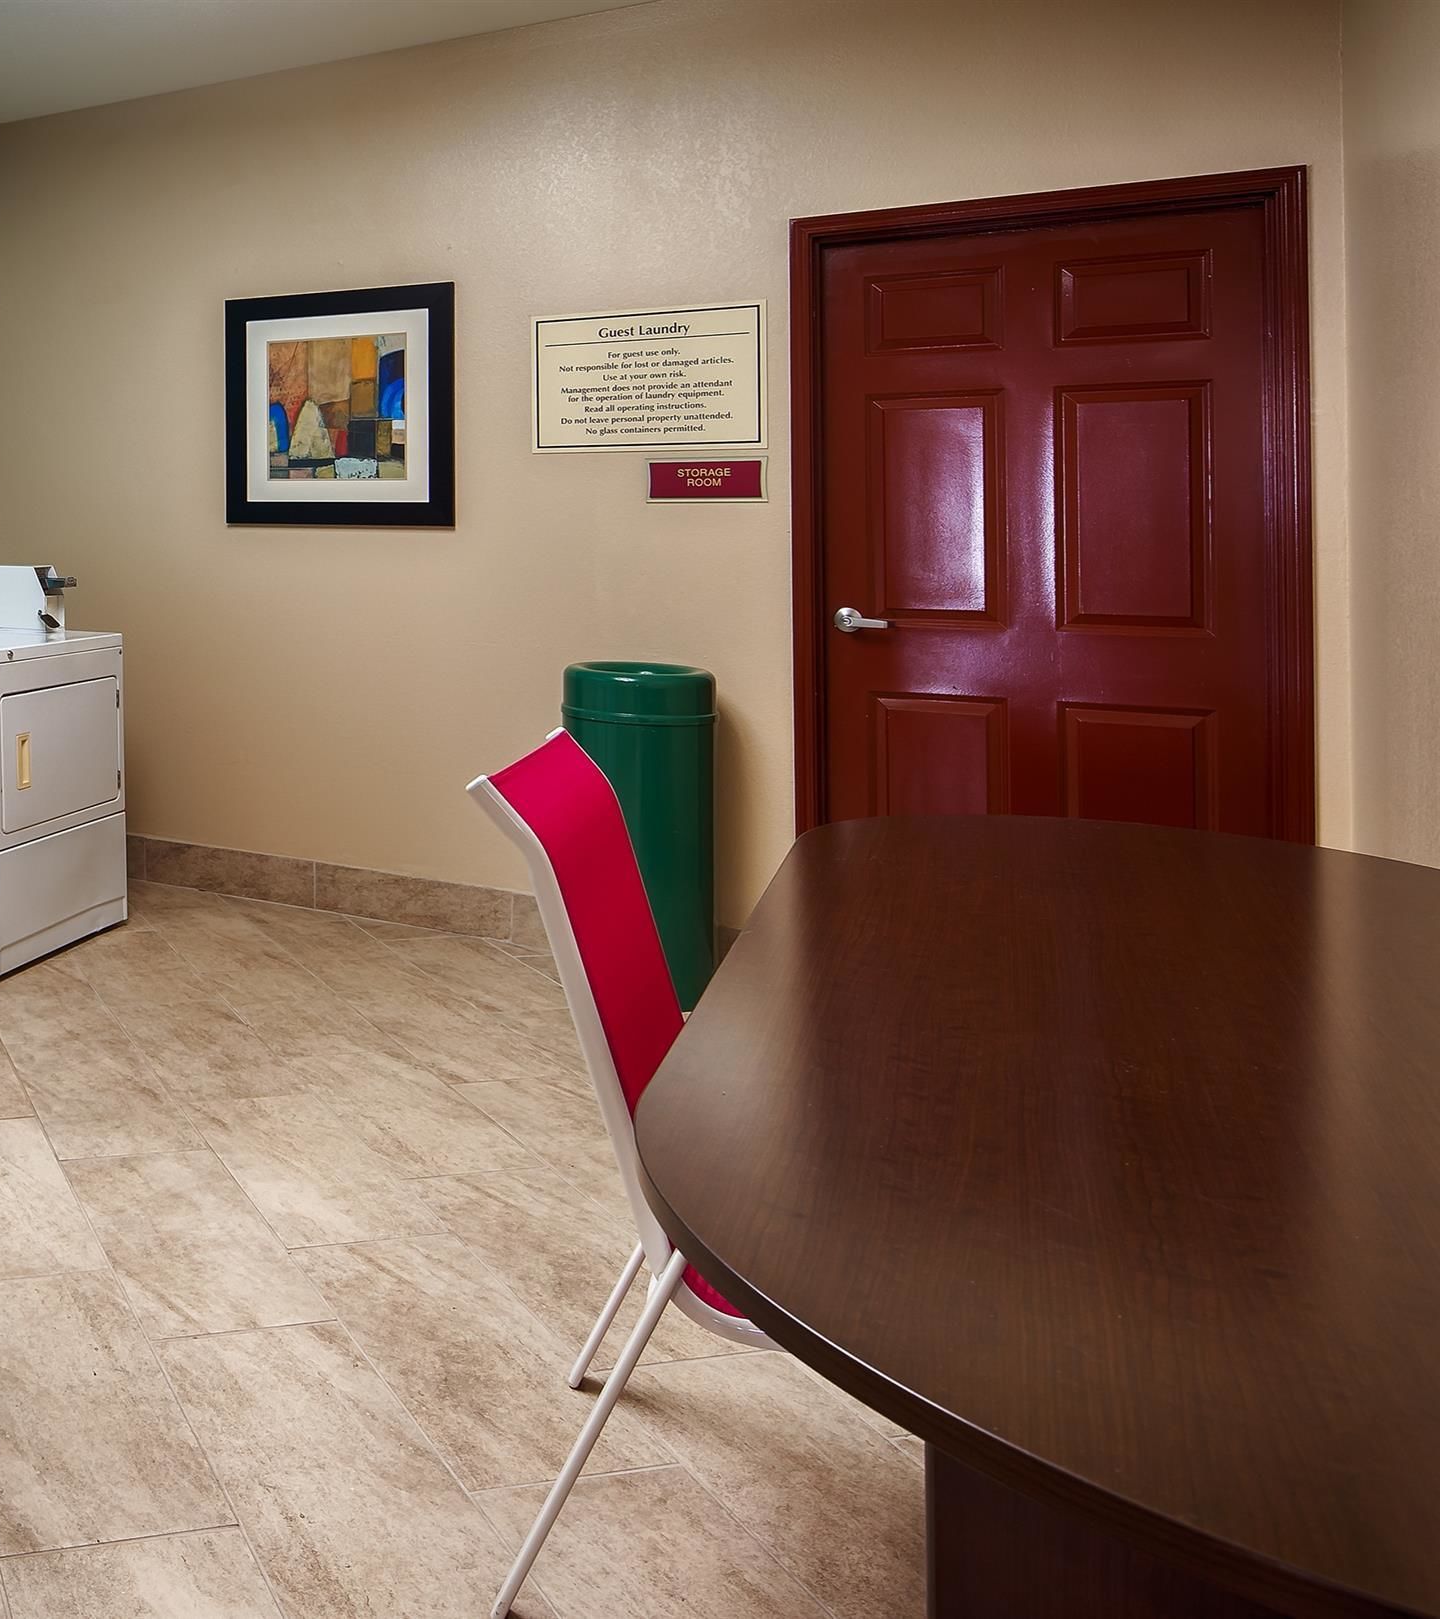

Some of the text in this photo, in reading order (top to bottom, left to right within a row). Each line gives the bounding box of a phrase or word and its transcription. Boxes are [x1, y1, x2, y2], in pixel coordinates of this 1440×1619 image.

[598, 322, 691, 339] Guest Laundry
[622, 350, 644, 360] guest
[661, 348, 681, 357] only.
[559, 365, 574, 373] Not
[575, 362, 619, 373] responsible
[620, 361, 633, 369] for
[662, 358, 699, 368] damaged
[701, 356, 734, 365] articles.
[602, 374, 618, 382] Use
[619, 373, 628, 381] at
[629, 373, 648, 381] your
[669, 370, 687, 378] risk.
[560, 386, 610, 395] Management
[611, 384, 630, 392] does
[647, 382, 678, 391] provide
[692, 379, 733, 388] attendant
[568, 389, 724, 403] for the operation of laundry equipment.
[584, 405, 604, 413] Read
[617, 403, 655, 413] operating
[656, 402, 707, 410] instructions.
[561, 417, 573, 425] Do
[589, 416, 609, 424] leave
[611, 415, 645, 424] personal
[646, 414, 681, 424] property
[683, 412, 733, 421] unattended.
[585, 424, 706, 436] No glass containers permitted.
[677, 467, 732, 478] STORAGE
[687, 478, 722, 487] ROOM
